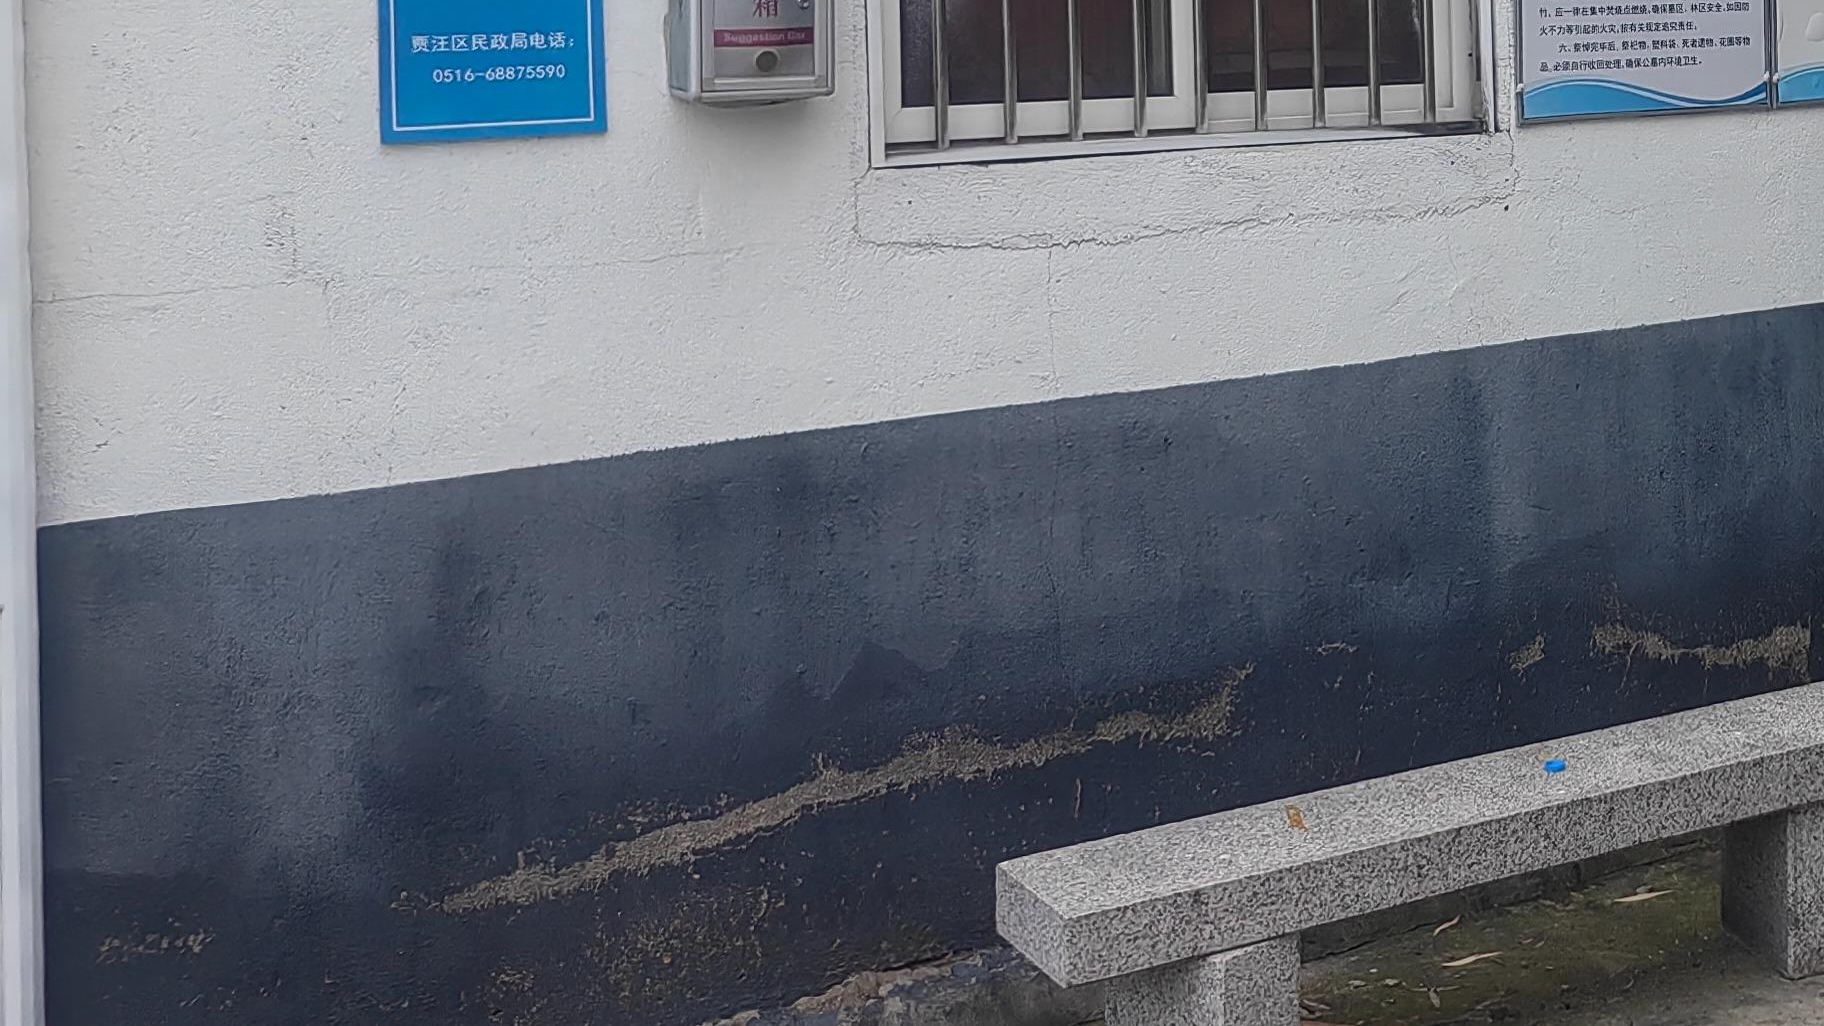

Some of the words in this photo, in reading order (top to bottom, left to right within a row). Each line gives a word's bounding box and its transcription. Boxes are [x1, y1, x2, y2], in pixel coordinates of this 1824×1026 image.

[411, 31, 575, 53] 贾汪区民政局电话：
[433, 64, 567, 83] 0516-68875590
